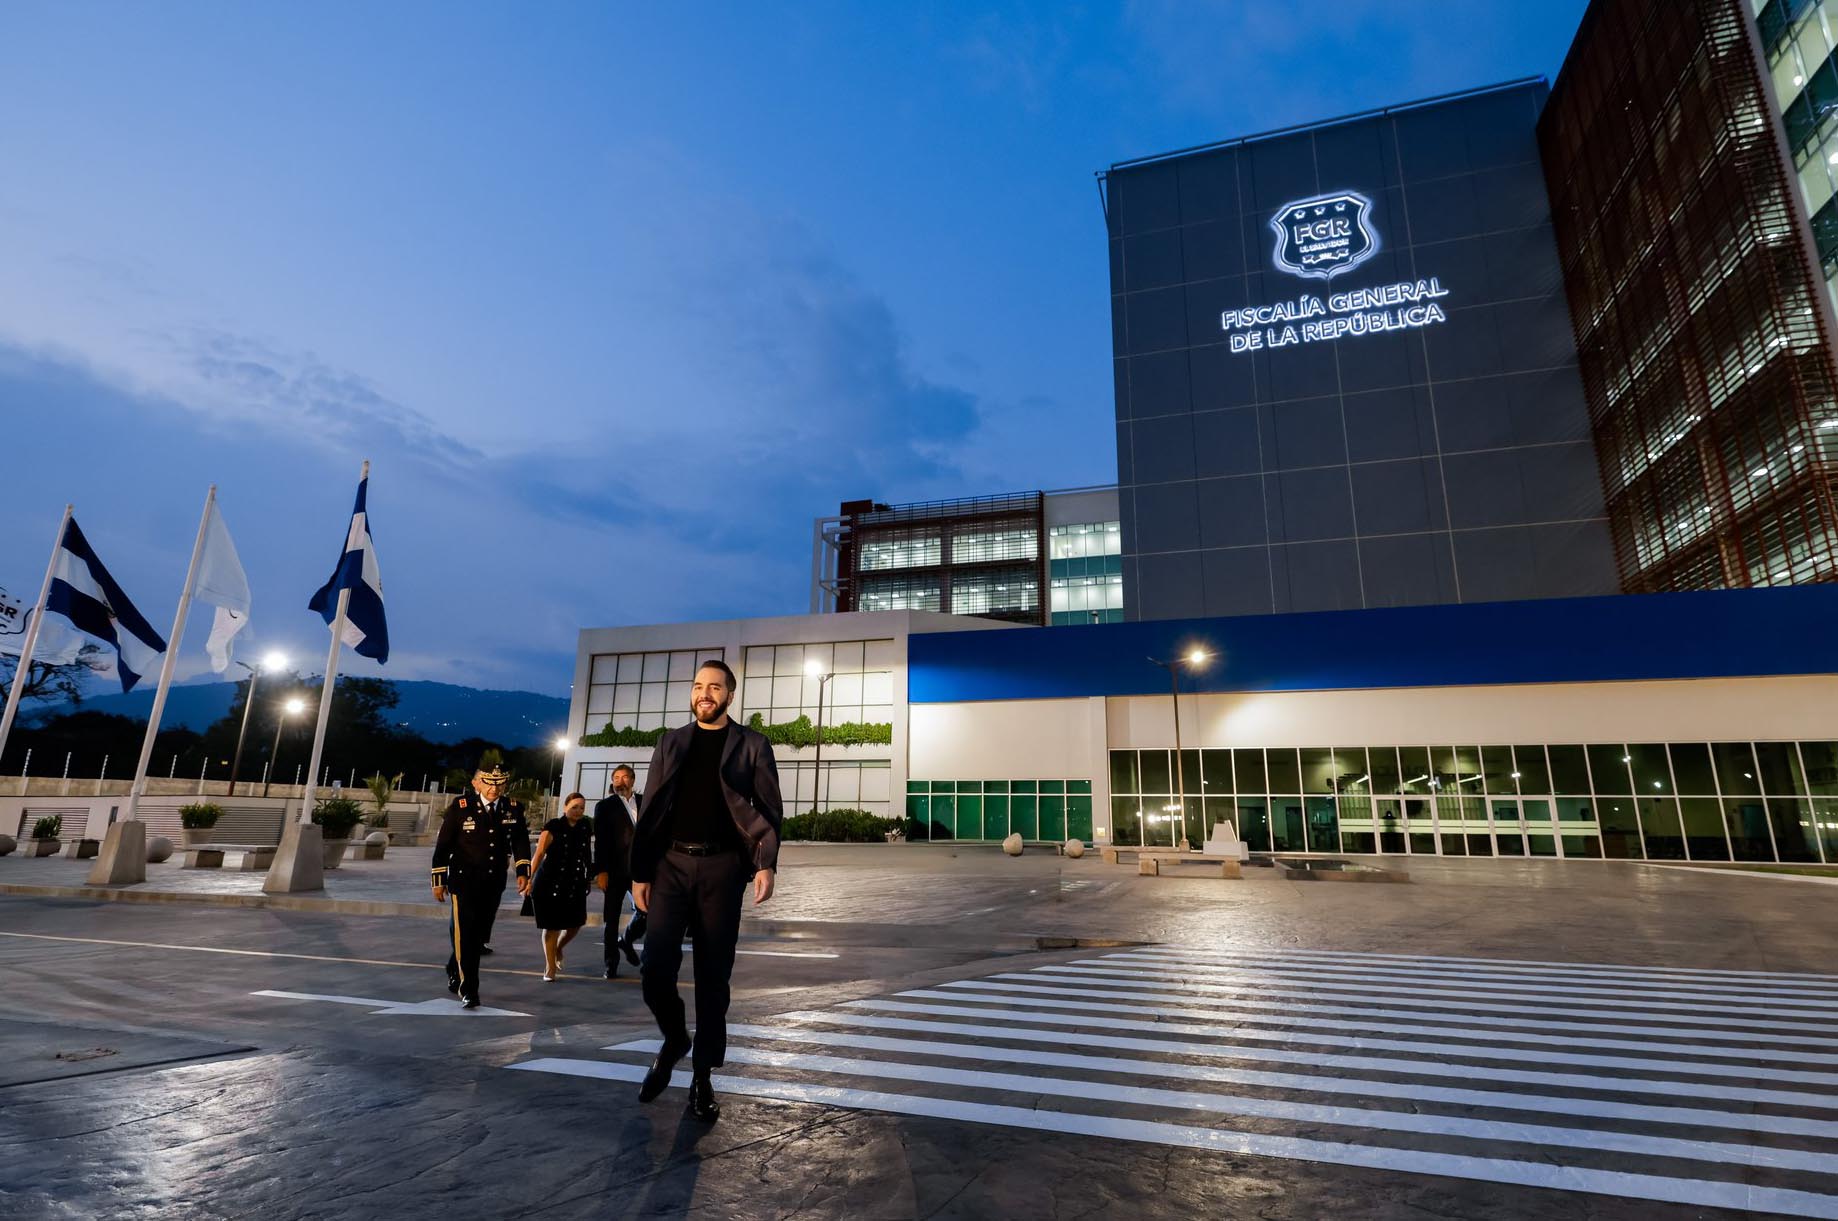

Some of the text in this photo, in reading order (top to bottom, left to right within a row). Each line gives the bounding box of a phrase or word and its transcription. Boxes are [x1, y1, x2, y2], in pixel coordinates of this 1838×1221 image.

[1294, 217, 1352, 244] FGR
[1222, 277, 1449, 329] FISCALÍA GENERAL
[1230, 304, 1446, 352] DE LA REPÚBLICA
